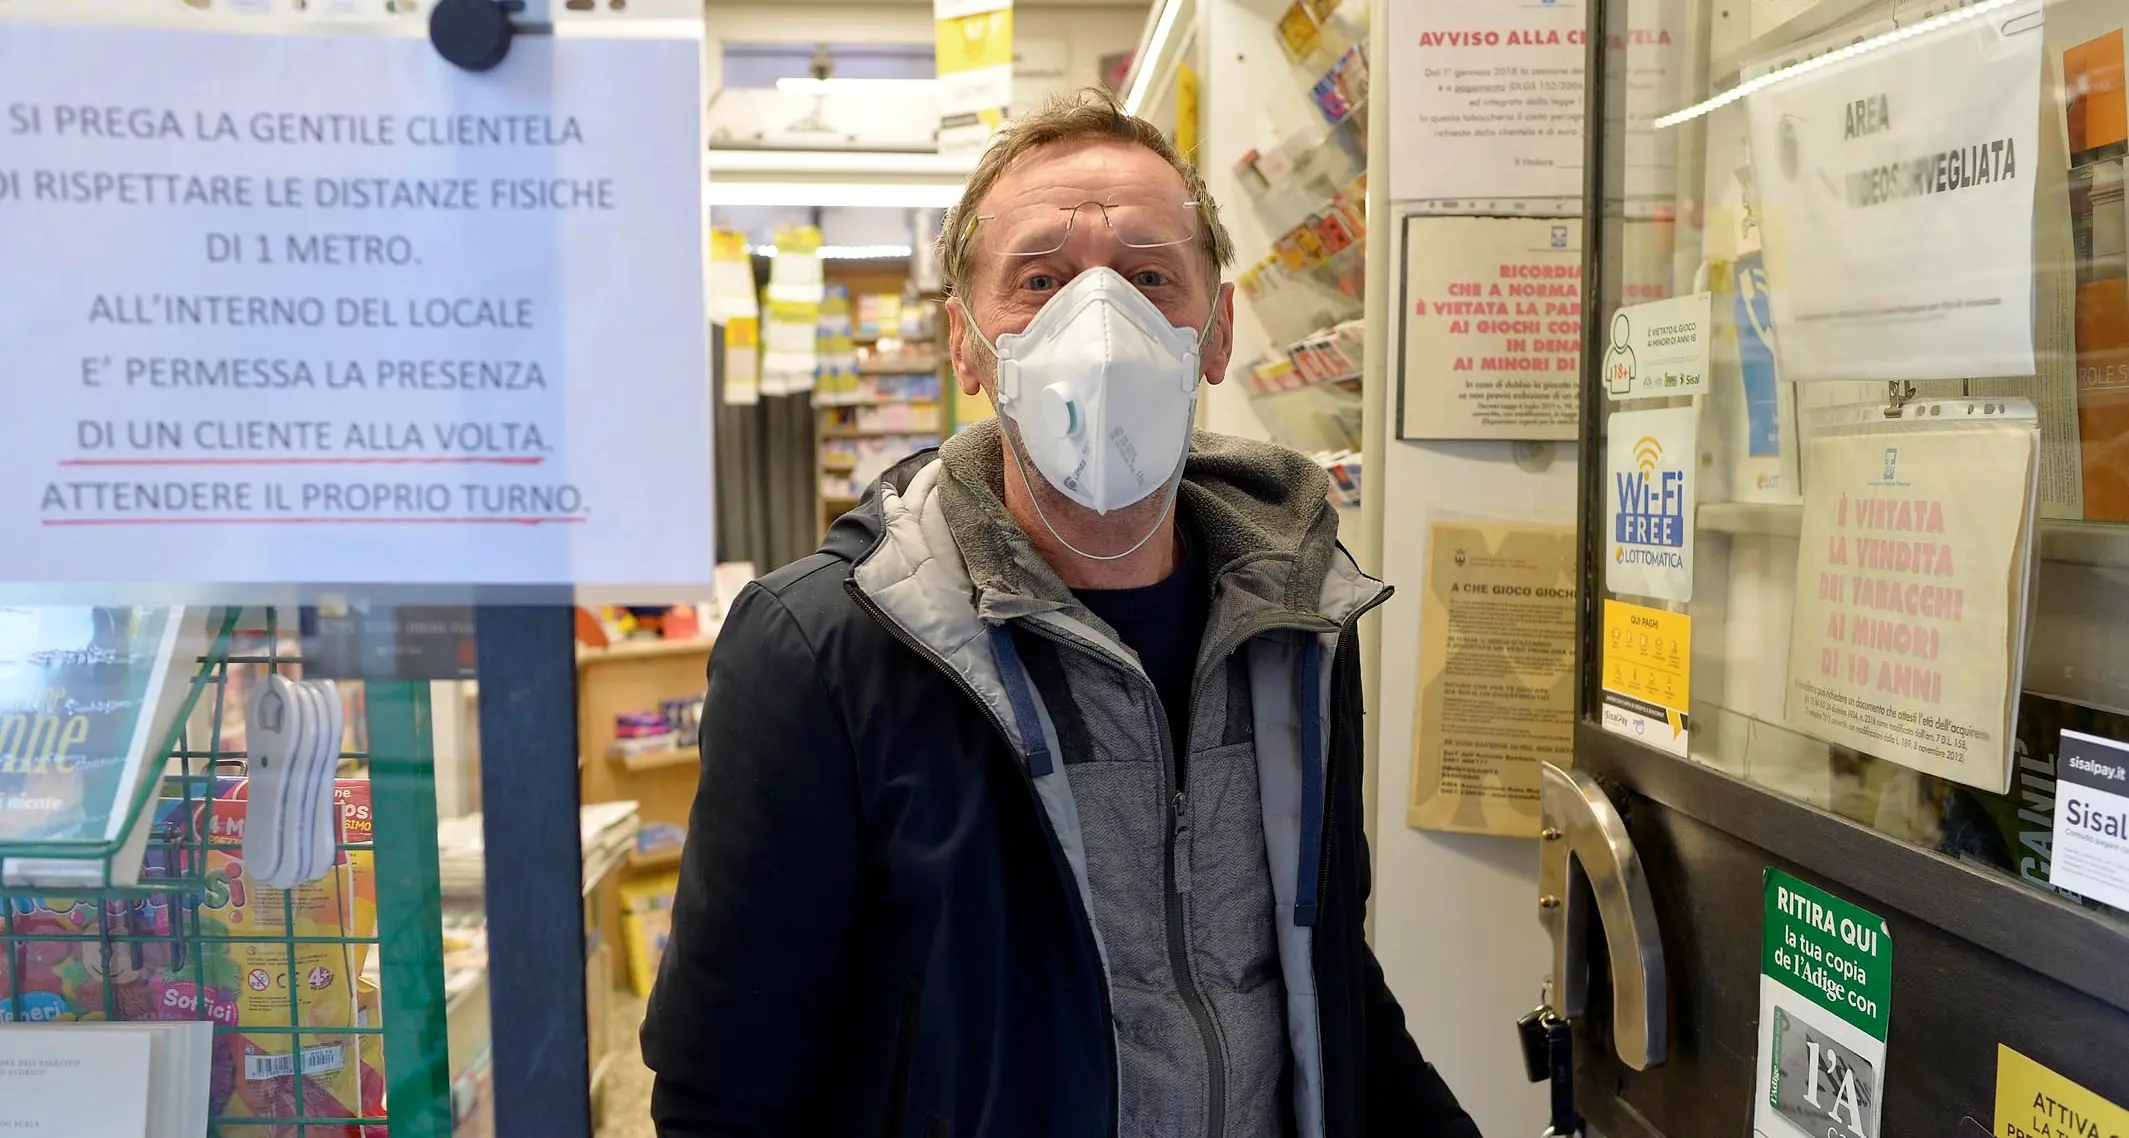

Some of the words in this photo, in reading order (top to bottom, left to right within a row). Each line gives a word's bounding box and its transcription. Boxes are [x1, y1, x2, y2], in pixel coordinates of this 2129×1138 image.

[1419, 31, 1499, 47] AVVISO
[1507, 31, 1560, 47] ALLA
[8, 103, 41, 135] SI
[54, 104, 184, 139] PREGA
[196, 112, 239, 142] LA
[251, 112, 394, 146] GENTILE
[406, 114, 583, 146] CLIENTELA
[1844, 93, 1890, 140] AREA
[34, 170, 252, 206] RISPETTARE
[265, 176, 302, 207] LE
[316, 178, 479, 209] DISTANZE
[491, 178, 615, 210] FISICHE
[206, 232, 241, 263] DI
[257, 234, 274, 263] 1
[286, 234, 422, 266] METRO.
[1448, 283, 1482, 298] CHE
[1488, 283, 1502, 297] A
[1508, 284, 1578, 298] NORMA
[89, 293, 325, 327] ALL'INTERNO
[336, 298, 398, 328] DEL
[408, 298, 533, 329] LOCALE
[1434, 302, 1508, 317] VIETATA
[1515, 302, 1538, 316] LA
[1450, 320, 1469, 334] AI
[1477, 320, 1540, 334] GIOCHI
[1506, 339, 1526, 353] IN
[81, 355, 112, 388] E'
[126, 357, 316, 389] PERMESSA
[325, 360, 366, 389] LA
[377, 360, 547, 390] PRESENZA
[1453, 357, 1473, 371] AI
[1481, 357, 1550, 371] MINORI
[1556, 357, 1576, 371] DI
[1686, 374, 1700, 385] Sisal
[77, 420, 113, 450] DI
[127, 420, 182, 450] UN
[194, 420, 332, 451] CLIENTE
[344, 421, 425, 451] ALLA
[434, 422, 554, 452] VOLTA.
[41, 481, 252, 511] ATTENDERE
[264, 482, 291, 511] IL
[302, 482, 450, 513] PROPRIO
[461, 484, 591, 514] TURNO.
[1616, 470, 1683, 517] Wi-Fi
[1838, 492, 1848, 528] È
[1855, 498, 1945, 534] VIETATA
[1625, 515, 1673, 546] FREE
[1624, 549, 1684, 569] LOTTOMATICA
[1829, 534, 1848, 565] LA
[1856, 537, 1954, 578] VENDITA
[1451, 583, 1459, 592] A
[1464, 583, 1488, 594] CHE
[1493, 585, 1531, 596] GIOCO
[1819, 571, 1844, 603] DEI
[1852, 576, 1964, 622] TABACCHI
[1630, 615, 1641, 626] QUI
[1641, 617, 1659, 629] PAGHI
[1826, 611, 1846, 642] AI
[1852, 616, 1940, 661] MINORI
[1821, 648, 1839, 679] DI
[1848, 653, 1870, 687] 18
[1876, 661, 1942, 705] ANNI
[1855, 695, 1886, 716] documento
[1886, 704, 1897, 718] che
[2069, 755, 2126, 781] sisalpay.it
[1777, 886, 1837, 937] RITIRA
[1840, 918, 1877, 957] QUI
[1785, 925, 1797, 949] la
[1800, 936, 1822, 963] tua
[1825, 951, 1867, 986] copia
[1774, 949, 1791, 970] de
[1793, 954, 1845, 1002] l'Adige
[1848, 990, 1877, 1019] con
[1803, 1041, 1868, 1138] l'A
[2033, 1092, 2099, 1138] ATTIVA
